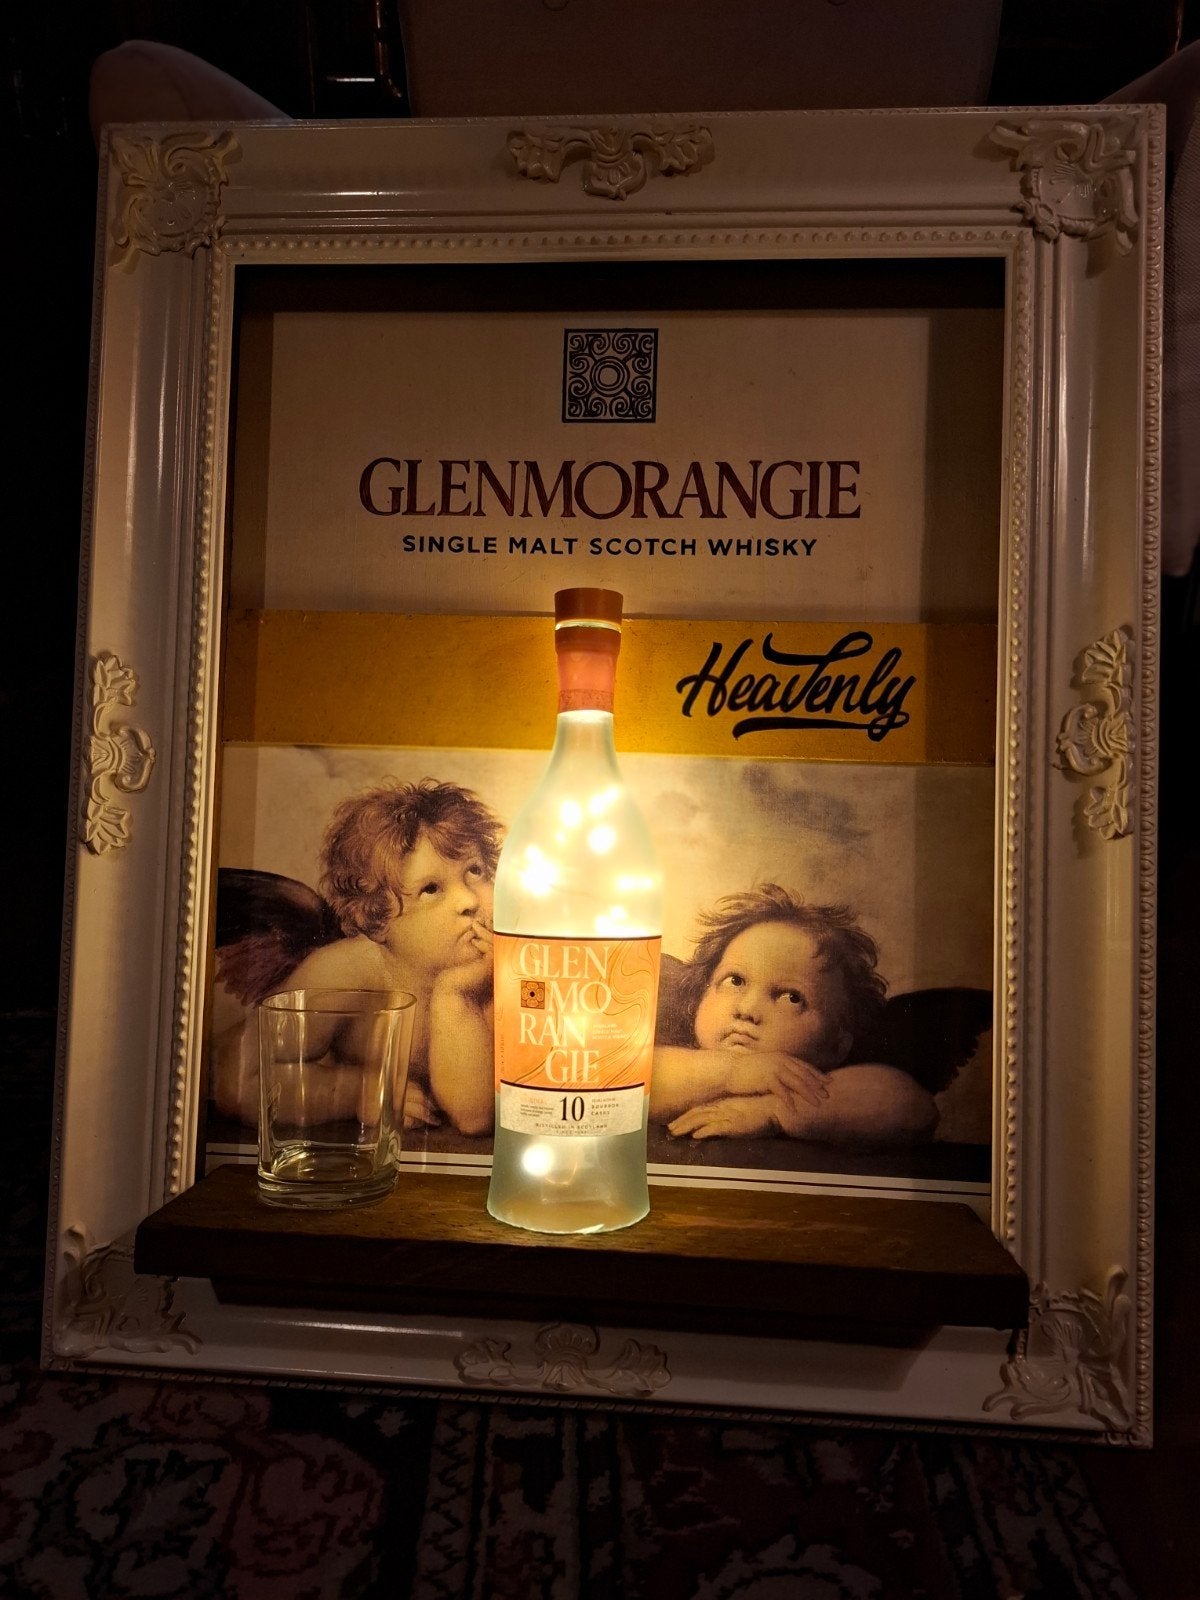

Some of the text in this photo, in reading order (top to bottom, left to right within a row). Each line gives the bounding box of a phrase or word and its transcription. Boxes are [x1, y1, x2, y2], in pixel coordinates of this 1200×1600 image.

[359, 457, 861, 520] GLENMORANGIE
[402, 535, 818, 557] SINGLE MALT SCOTCH WHISKY
[676, 630, 917, 741] Heavenly
[519, 942, 611, 980] GLEN
[547, 980, 612, 1015] MO
[519, 1012, 587, 1048] RAN
[545, 1049, 600, 1084] GIE
[559, 1095, 585, 1122] 10
